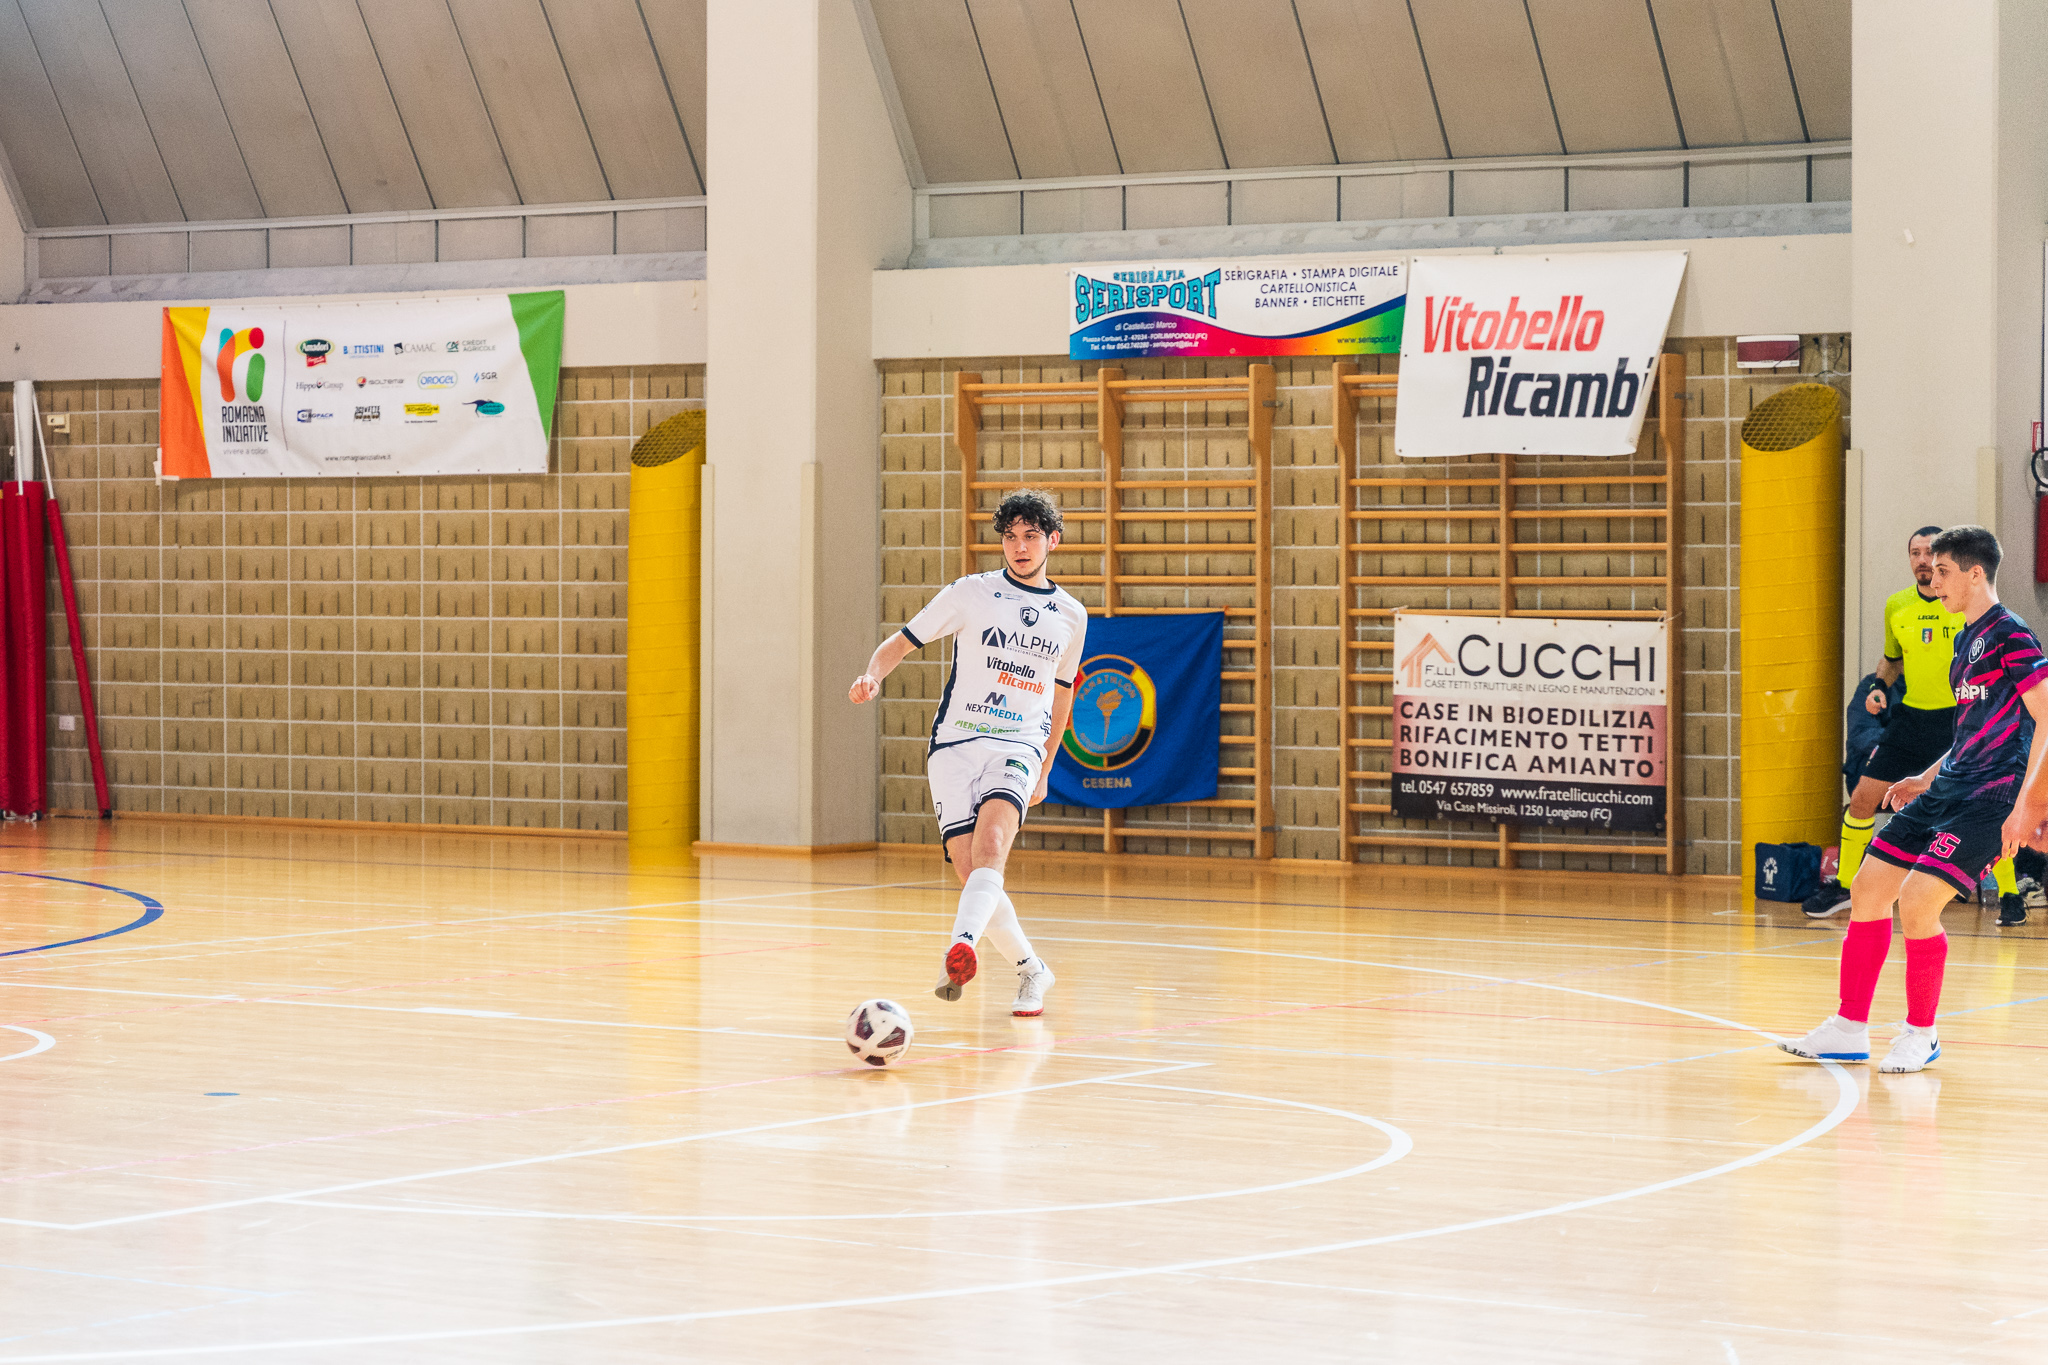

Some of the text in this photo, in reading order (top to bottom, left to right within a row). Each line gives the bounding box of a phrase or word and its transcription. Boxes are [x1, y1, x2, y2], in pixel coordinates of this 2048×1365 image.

[1113, 269, 1186, 284] SERIGRAFIA
[1225, 265, 1398, 281] SERIGRAFIA STAMPA DIGITALE
[1075, 268, 1221, 325] SERISPORT
[1260, 281, 1357, 295] CARTELLONISTICA
[1255, 295, 1365, 308] BANNER ETICHETTE
[1423, 295, 1605, 353] Vitobello
[302, 341, 329, 352] Amadori
[343, 344, 384, 355] BTTISTINI
[404, 343, 437, 353] CAMAC
[481, 372, 498, 380] SGR
[221, 405, 266, 423] ROMAGNA
[222, 425, 269, 443] INIZIATIVE
[1007, 631, 1060, 658] ALPHA
[1458, 634, 1655, 682] CUCCHI
[986, 656, 1036, 679] Vitobello
[1425, 665, 1456, 676] F.LLI
[997, 671, 1046, 696] Ricambi
[1424, 679, 1656, 696] CASE TETTI STRUTTURE IN LEGNO E MANUTENZIONI
[965, 703, 1023, 722] NEXTMEDIA
[1400, 701, 1655, 730] CASE IN BIOEDILIZIA
[1400, 725, 1653, 754] RIFACIMENTO TETTI
[1400, 749, 1654, 778] BONIFICA AMIANTO
[1082, 777, 1133, 788] CESENA
[1401, 781, 1653, 805] tel. 0547 657859 www.fratellicucchi.com
[1436, 800, 1612, 822] Via Case Missiroli, 1250 Longiano (FC)
[1928, 832, 1961, 858] 15
